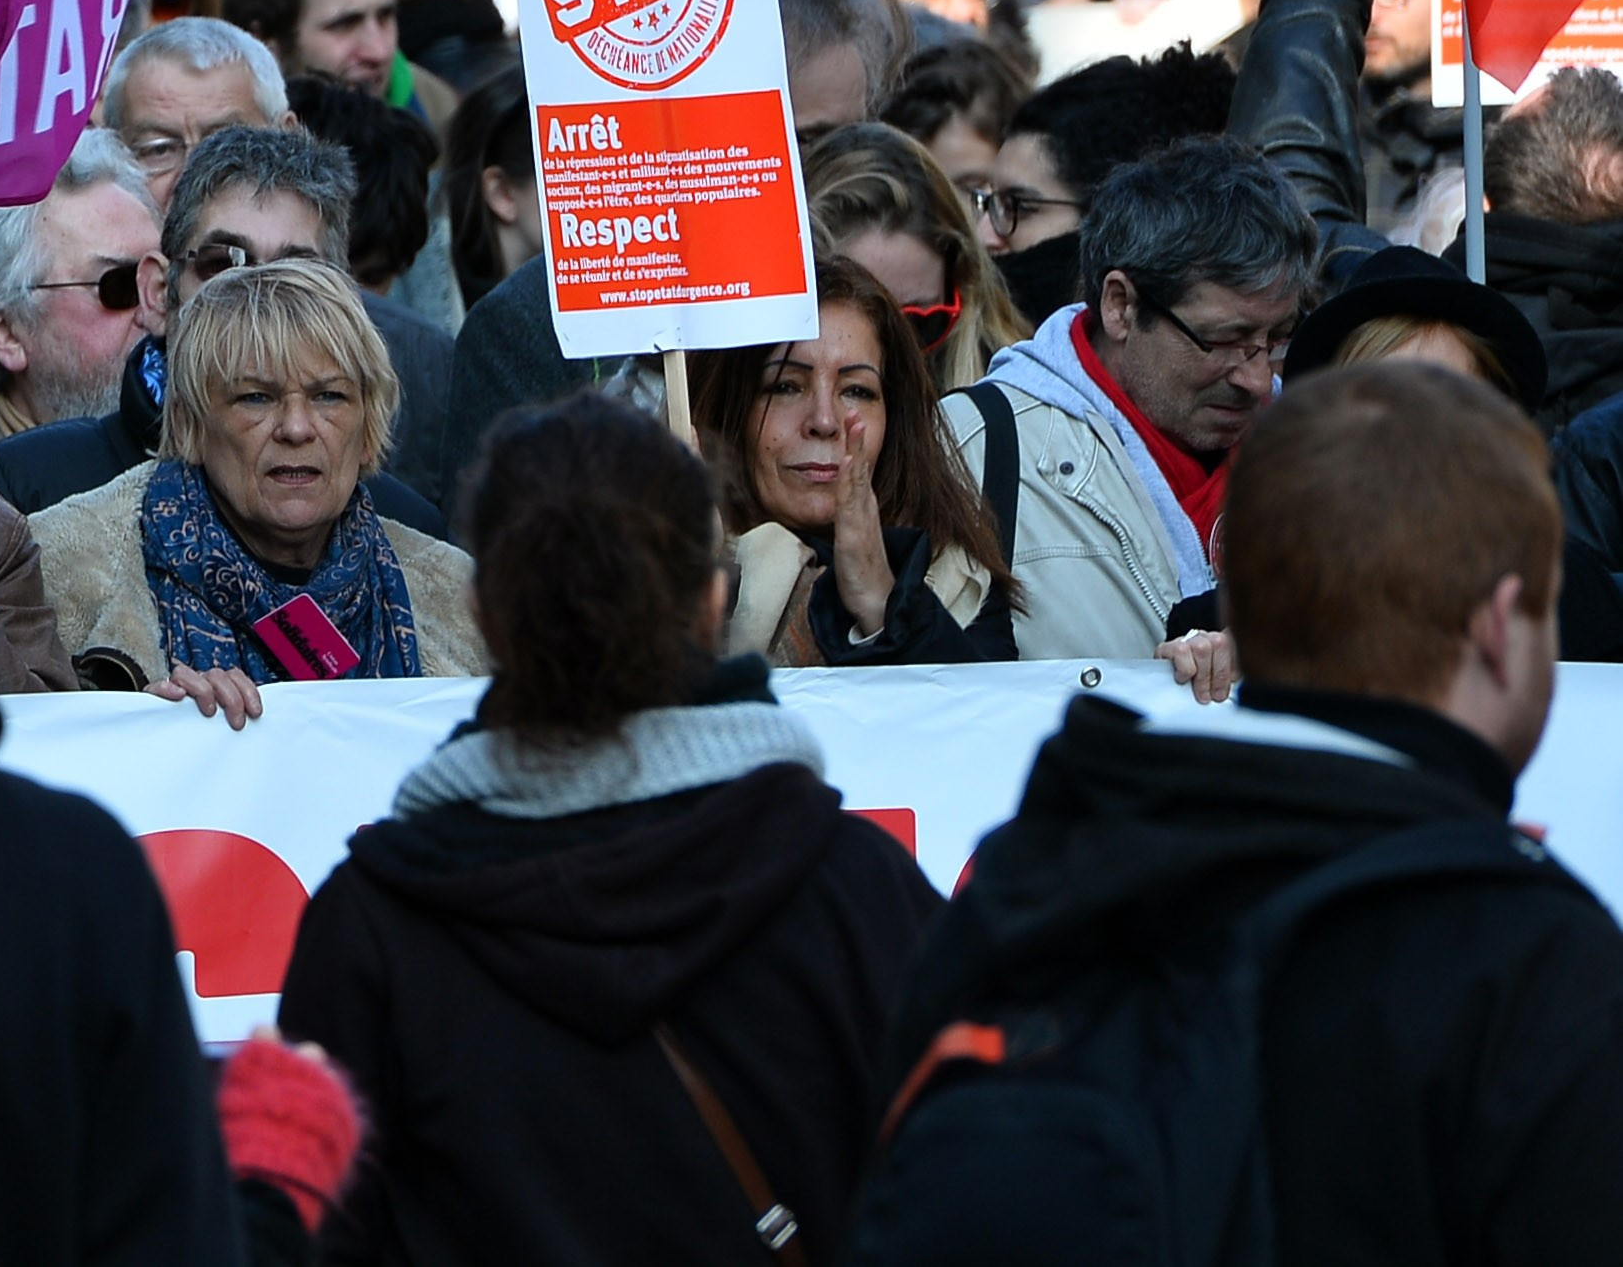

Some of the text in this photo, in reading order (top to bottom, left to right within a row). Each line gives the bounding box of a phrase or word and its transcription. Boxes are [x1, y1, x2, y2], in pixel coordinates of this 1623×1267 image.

[654, 51, 669, 73] DE
[547, 112, 623, 153] Arrêt
[544, 157, 555, 170] de
[556, 157, 565, 169] la
[566, 155, 615, 170] répression
[617, 153, 628, 165] et
[629, 151, 642, 164] de
[644, 151, 655, 163] la
[727, 145, 749, 158] des
[619, 167, 629, 179] et
[684, 162, 703, 175] des
[704, 156, 782, 173] mouvements
[584, 182, 602, 195] des
[761, 171, 778, 182] ou
[633, 193, 653, 206] des
[694, 186, 762, 205] populaires.
[559, 207, 681, 254] Respect
[557, 259, 569, 271] de
[570, 258, 579, 270] la
[580, 254, 611, 270] liberté
[612, 255, 625, 268] de
[556, 273, 569, 285] de
[569, 273, 580, 284] se
[581, 270, 611, 283] réunir
[612, 269, 623, 282] et
[623, 267, 636, 281] de
[599, 281, 751, 305] www.stopetatdurgence.org
